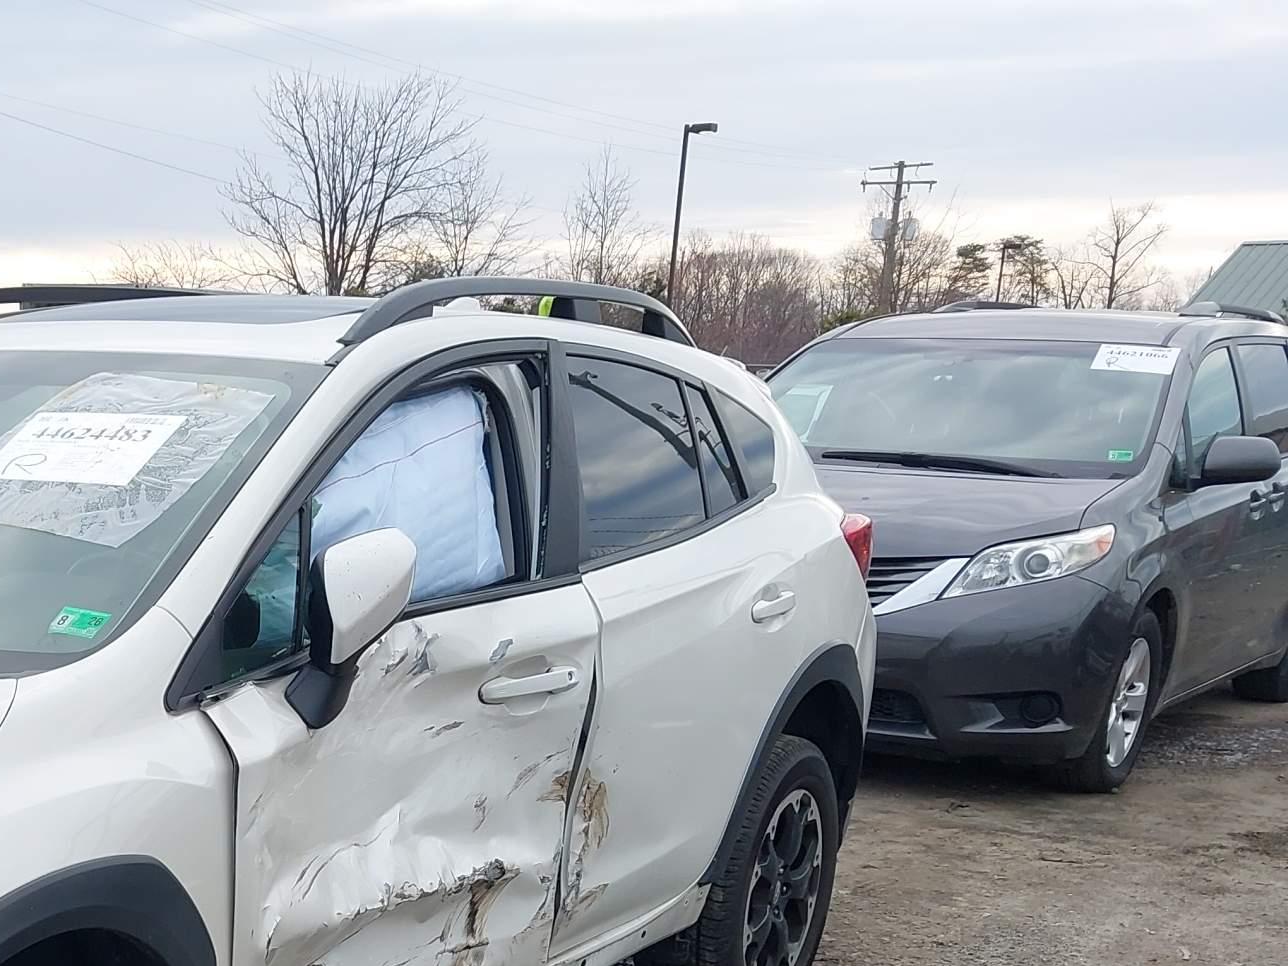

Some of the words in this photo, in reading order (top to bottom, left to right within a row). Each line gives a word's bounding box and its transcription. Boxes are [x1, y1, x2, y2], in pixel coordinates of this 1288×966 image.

[32, 425, 152, 442] 44624483
[1, 453, 47, 475] R
[57, 615, 69, 625] 8
